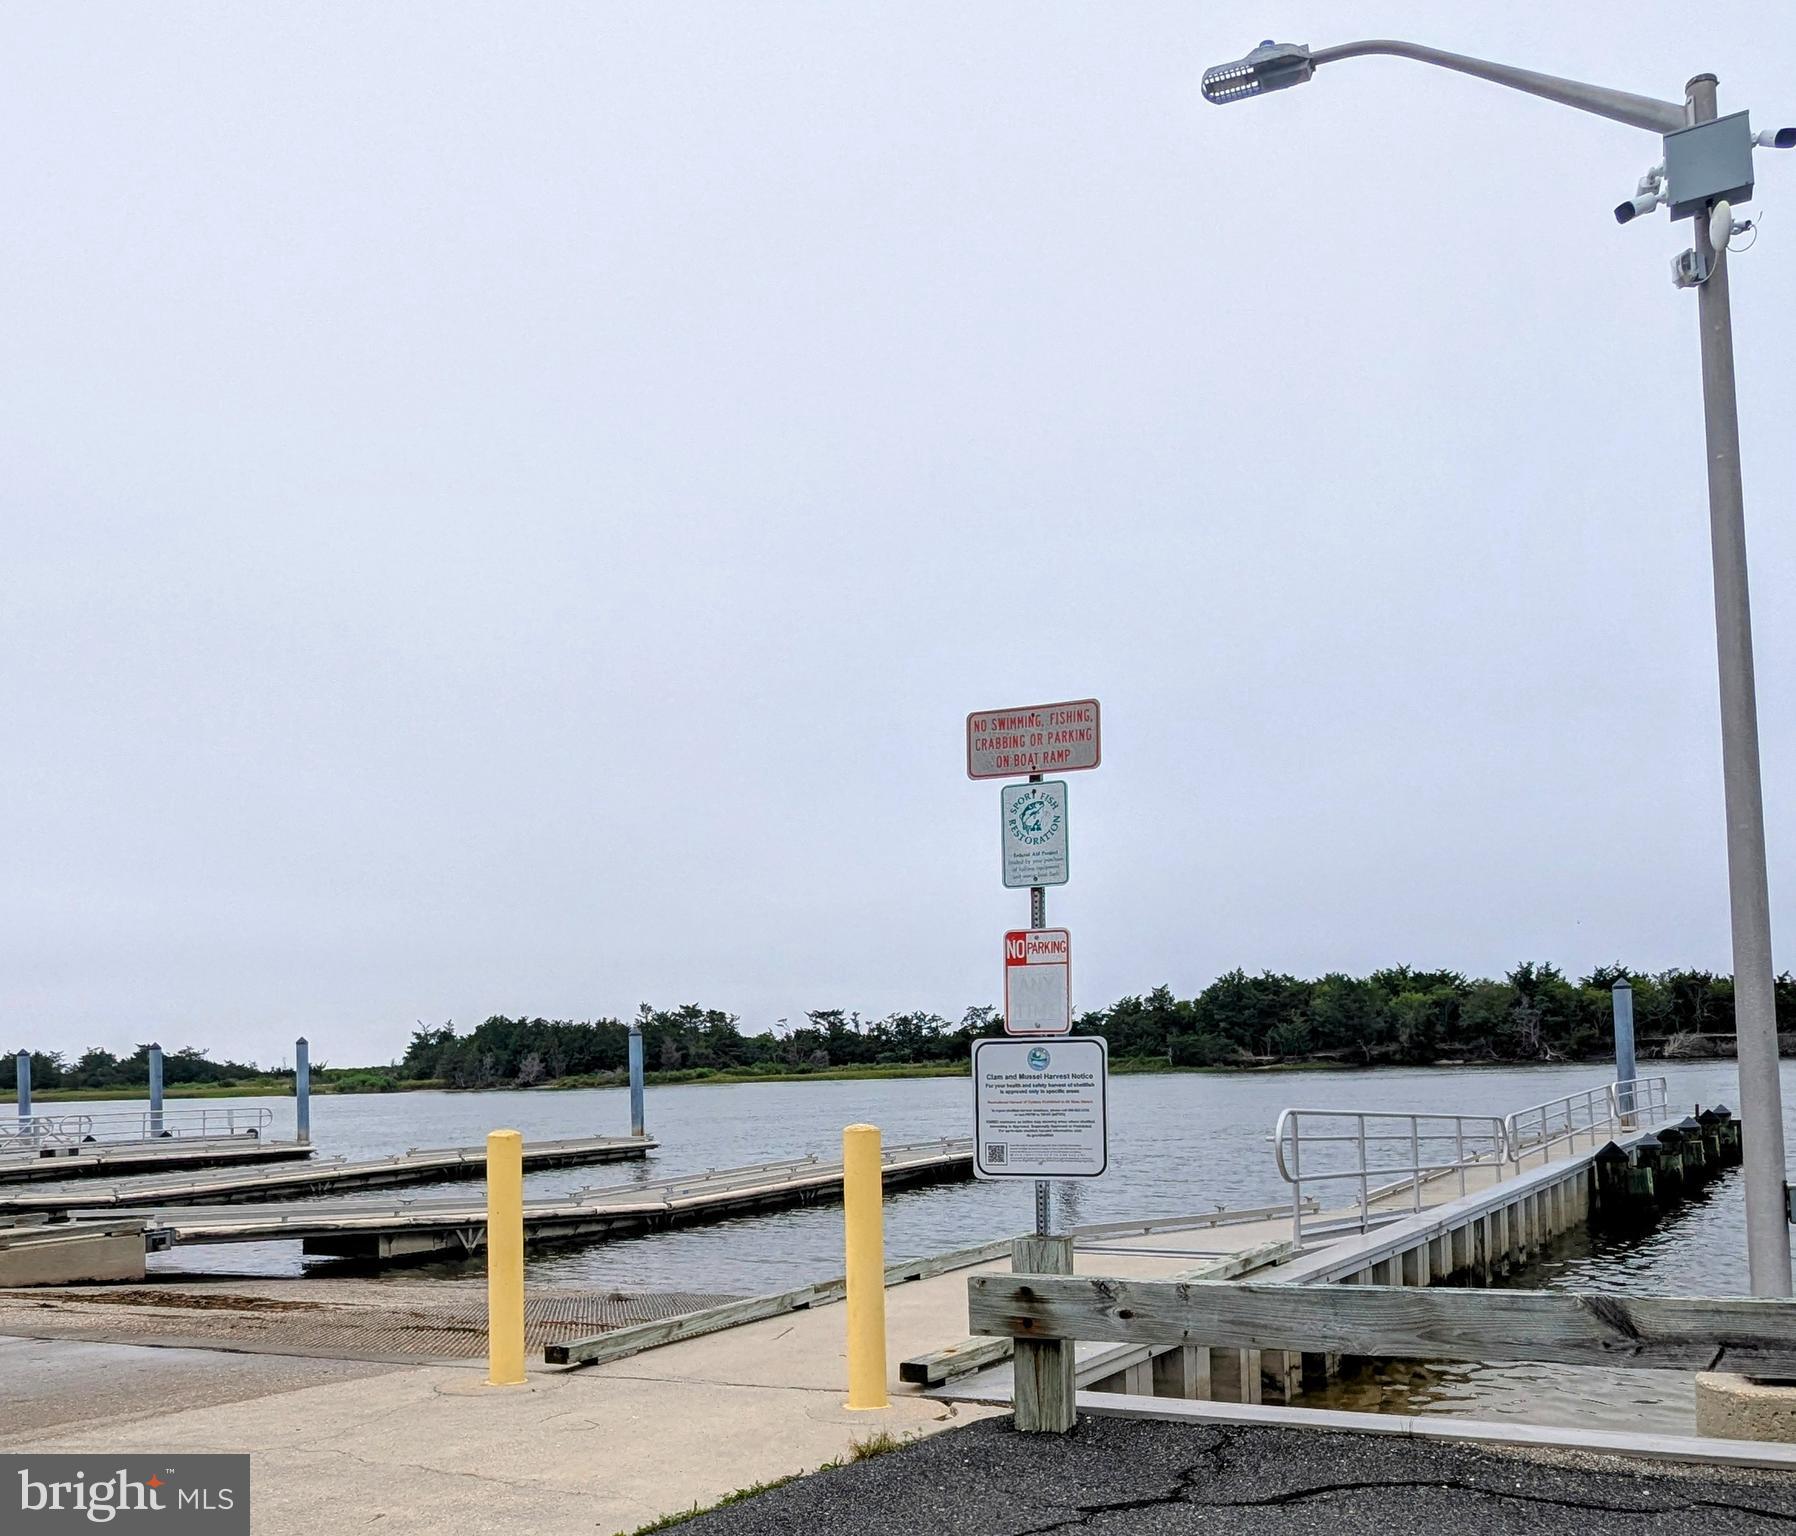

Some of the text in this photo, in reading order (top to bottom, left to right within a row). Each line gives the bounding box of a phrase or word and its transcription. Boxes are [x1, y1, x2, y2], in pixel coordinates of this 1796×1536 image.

[974, 719, 987, 732] NO
[975, 728, 1092, 752] CRABBING OR PARKING
[996, 749, 1071, 769] ON BOAT RAMP
[1010, 790, 1059, 815] SPORT FISH
[1008, 815, 1061, 846] RESTORATION
[1007, 939, 1066, 959] NO PARKING
